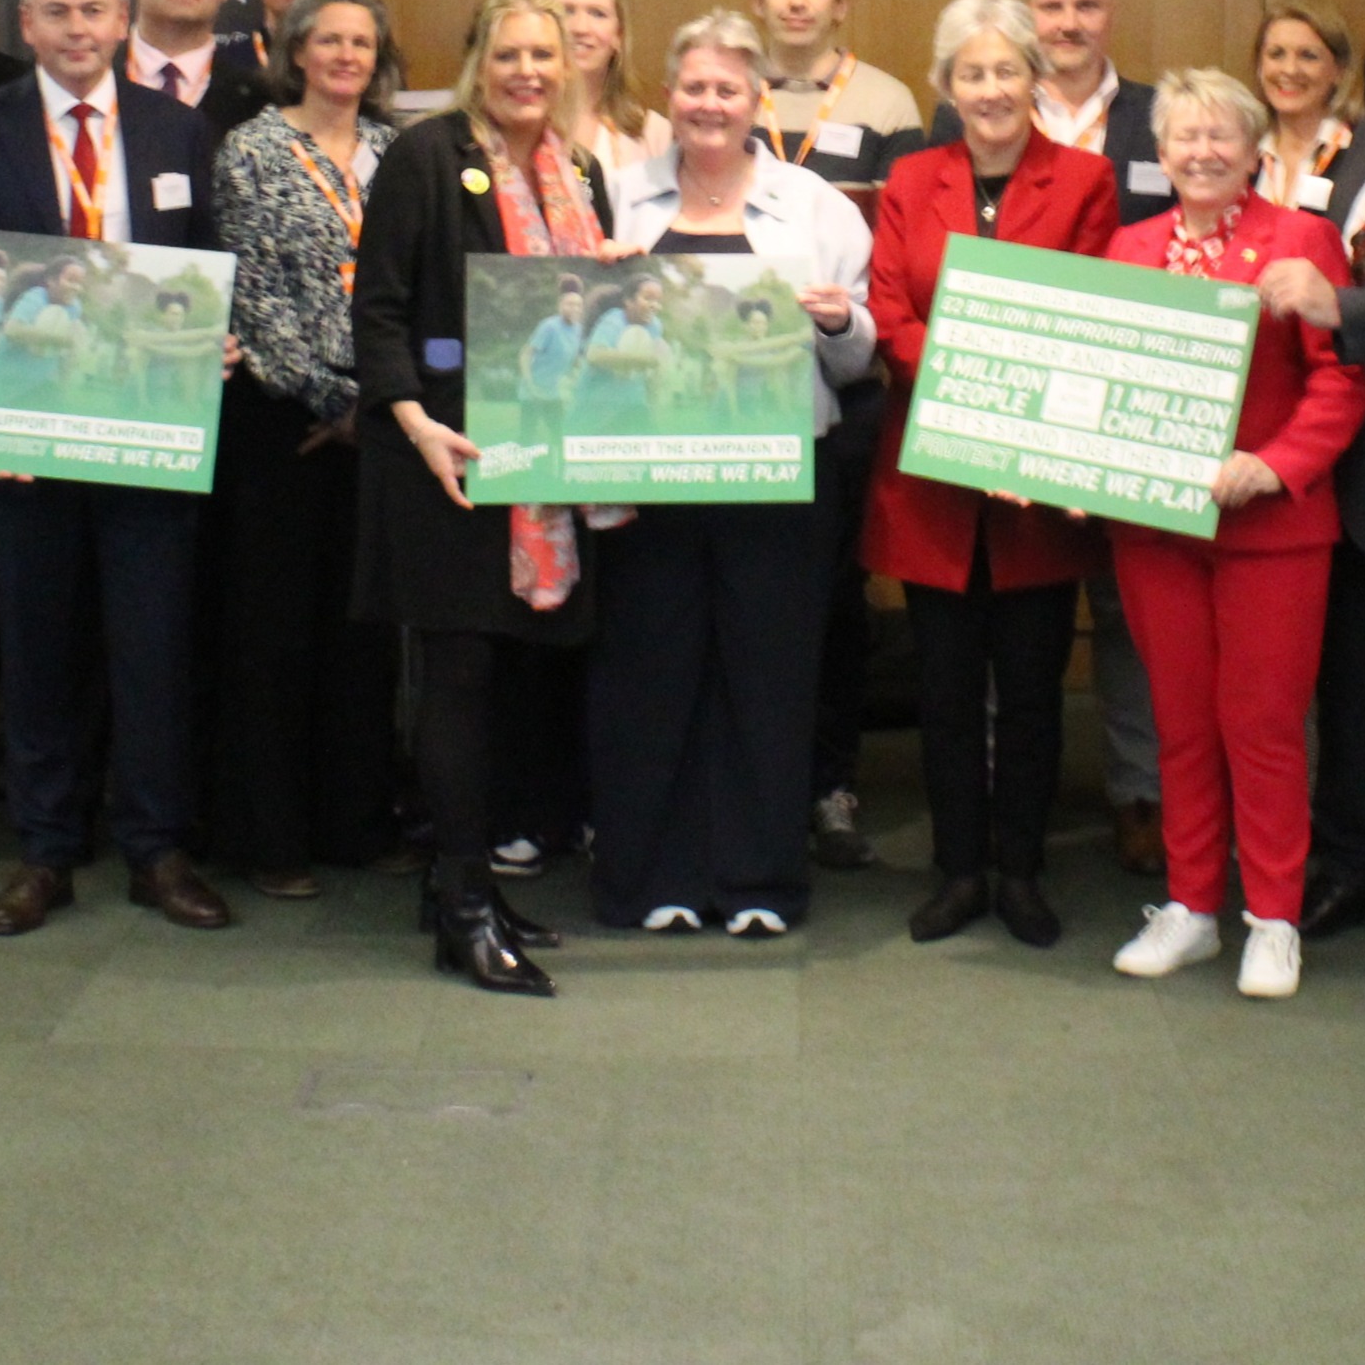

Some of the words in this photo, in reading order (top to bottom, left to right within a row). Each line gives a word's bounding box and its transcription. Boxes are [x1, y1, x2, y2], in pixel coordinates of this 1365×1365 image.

[963, 298, 1032, 328] BILLION
[1032, 312, 1053, 332] IN
[1054, 315, 1142, 350] IMPROVED
[1140, 330, 1245, 370] WELLBEING
[928, 348, 949, 373] 4
[948, 351, 1050, 394] MILLION
[948, 323, 1005, 352] EACH
[1010, 335, 1065, 364] YEAR
[1069, 347, 1117, 374] AND
[1119, 355, 1223, 395] SUPPORT
[934, 375, 1033, 416] PEOPLE
[1108, 384, 1126, 409] 1
[1125, 386, 1234, 430] MILLION
[62, 419, 90, 434] THE
[96, 423, 176, 442] CAMPAIGN
[180, 431, 198, 445] TO
[579, 442, 651, 454] SUPPORT
[657, 442, 684, 454] THE
[690, 442, 772, 454] CAMPAIGN
[776, 442, 797, 454] TO
[931, 404, 991, 434] LET'S
[994, 417, 1061, 449] STAND
[1065, 431, 1173, 471] TOGETHER
[1176, 454, 1207, 478] TO
[1101, 408, 1228, 456] CHILDREN
[53, 442, 120, 463] WHERE
[120, 448, 152, 466] WE
[152, 452, 203, 472] PLAY
[651, 464, 718, 483] WHERE
[719, 464, 751, 483] WE
[752, 464, 801, 483] PLAY
[912, 430, 1018, 473] PROTECT
[1016, 452, 1105, 492] WHERE
[1101, 470, 1148, 501] WE
[1141, 477, 1212, 515] PLAY
